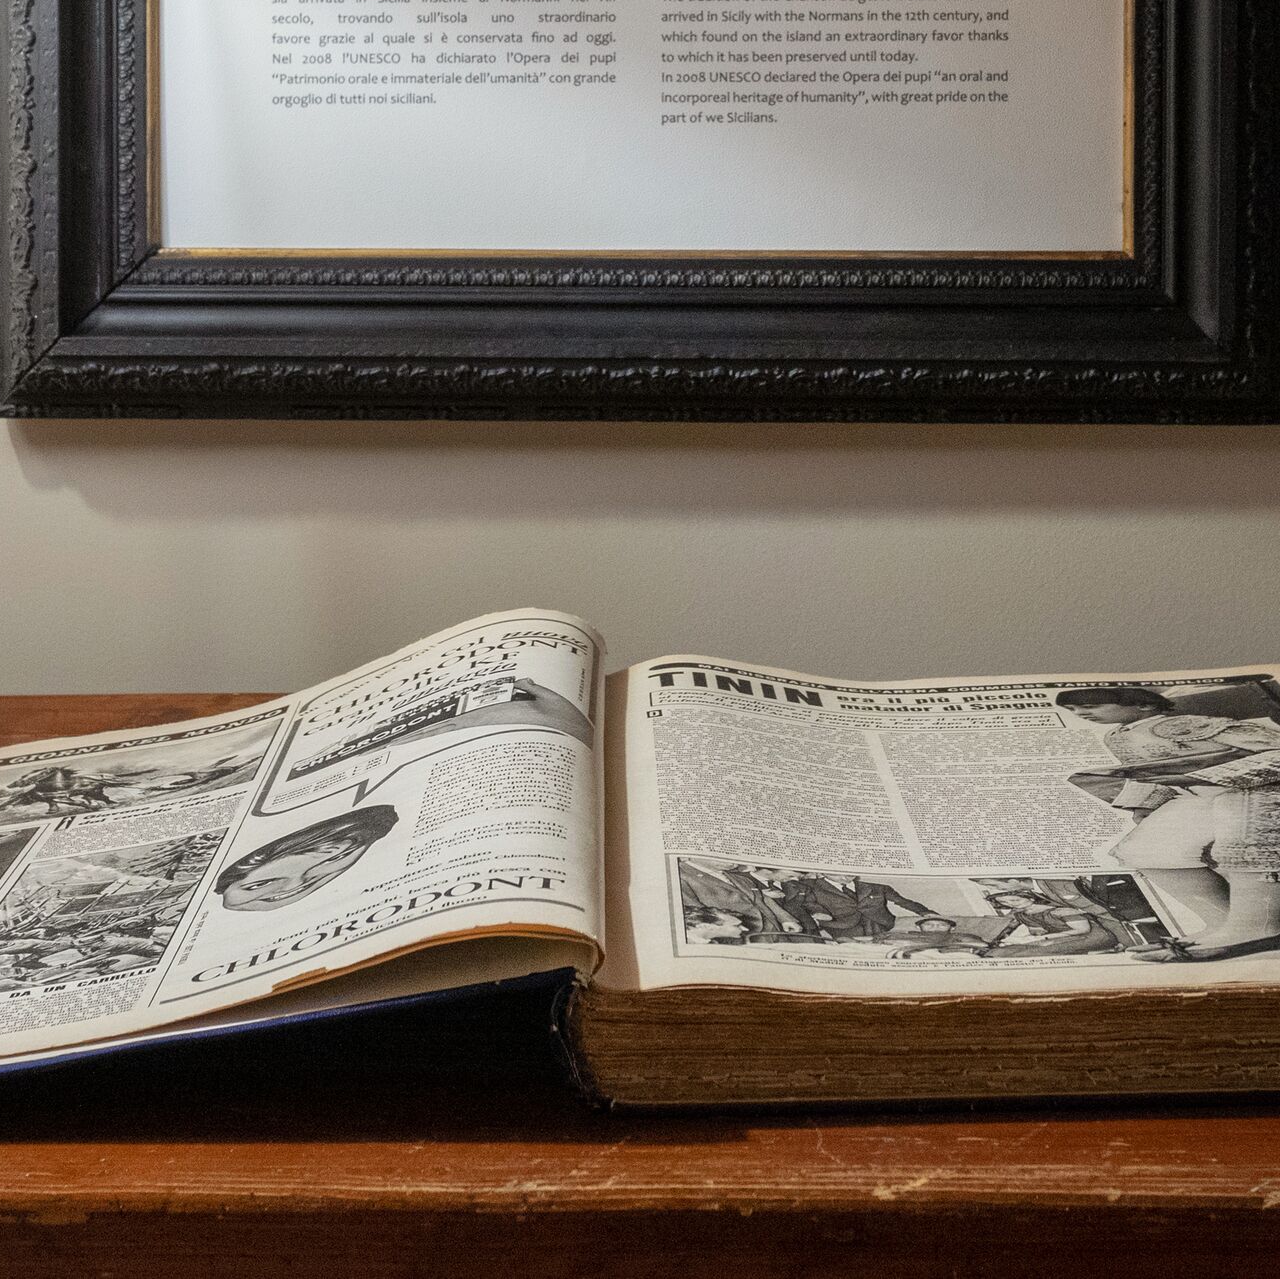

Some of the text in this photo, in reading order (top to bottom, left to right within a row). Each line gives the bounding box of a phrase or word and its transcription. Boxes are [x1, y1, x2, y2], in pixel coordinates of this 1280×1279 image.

[272, 11, 313, 25] secolo,
[338, 11, 392, 23] trovando
[491, 14, 514, 23] uno
[538, 10, 616, 23] straordinario
[440, 637, 485, 658] col
[303, 670, 450, 736] caramelle
[471, 651, 520, 669] KF
[307, 639, 587, 724] CHLORODONT
[393, 661, 517, 710] omaggio
[648, 671, 823, 707] TININ
[697, 664, 731, 672] MAI
[738, 670, 826, 689] DISGRAZIA
[947, 683, 1046, 692] COMMOSSE
[1140, 678, 1225, 686] PUBBLICO
[837, 691, 1048, 705] era il più piccolo
[840, 699, 1052, 712] matador di Spagna
[9, 745, 107, 764] GIORNI
[117, 736, 171, 748] NEL
[182, 709, 283, 738] MONDO
[292, 703, 458, 771] CHLORODONT
[191, 875, 566, 982] CHLORODONT
[8, 990, 32, 999] DA
[43, 984, 67, 993] UN
[76, 967, 158, 987] CARRELLO
